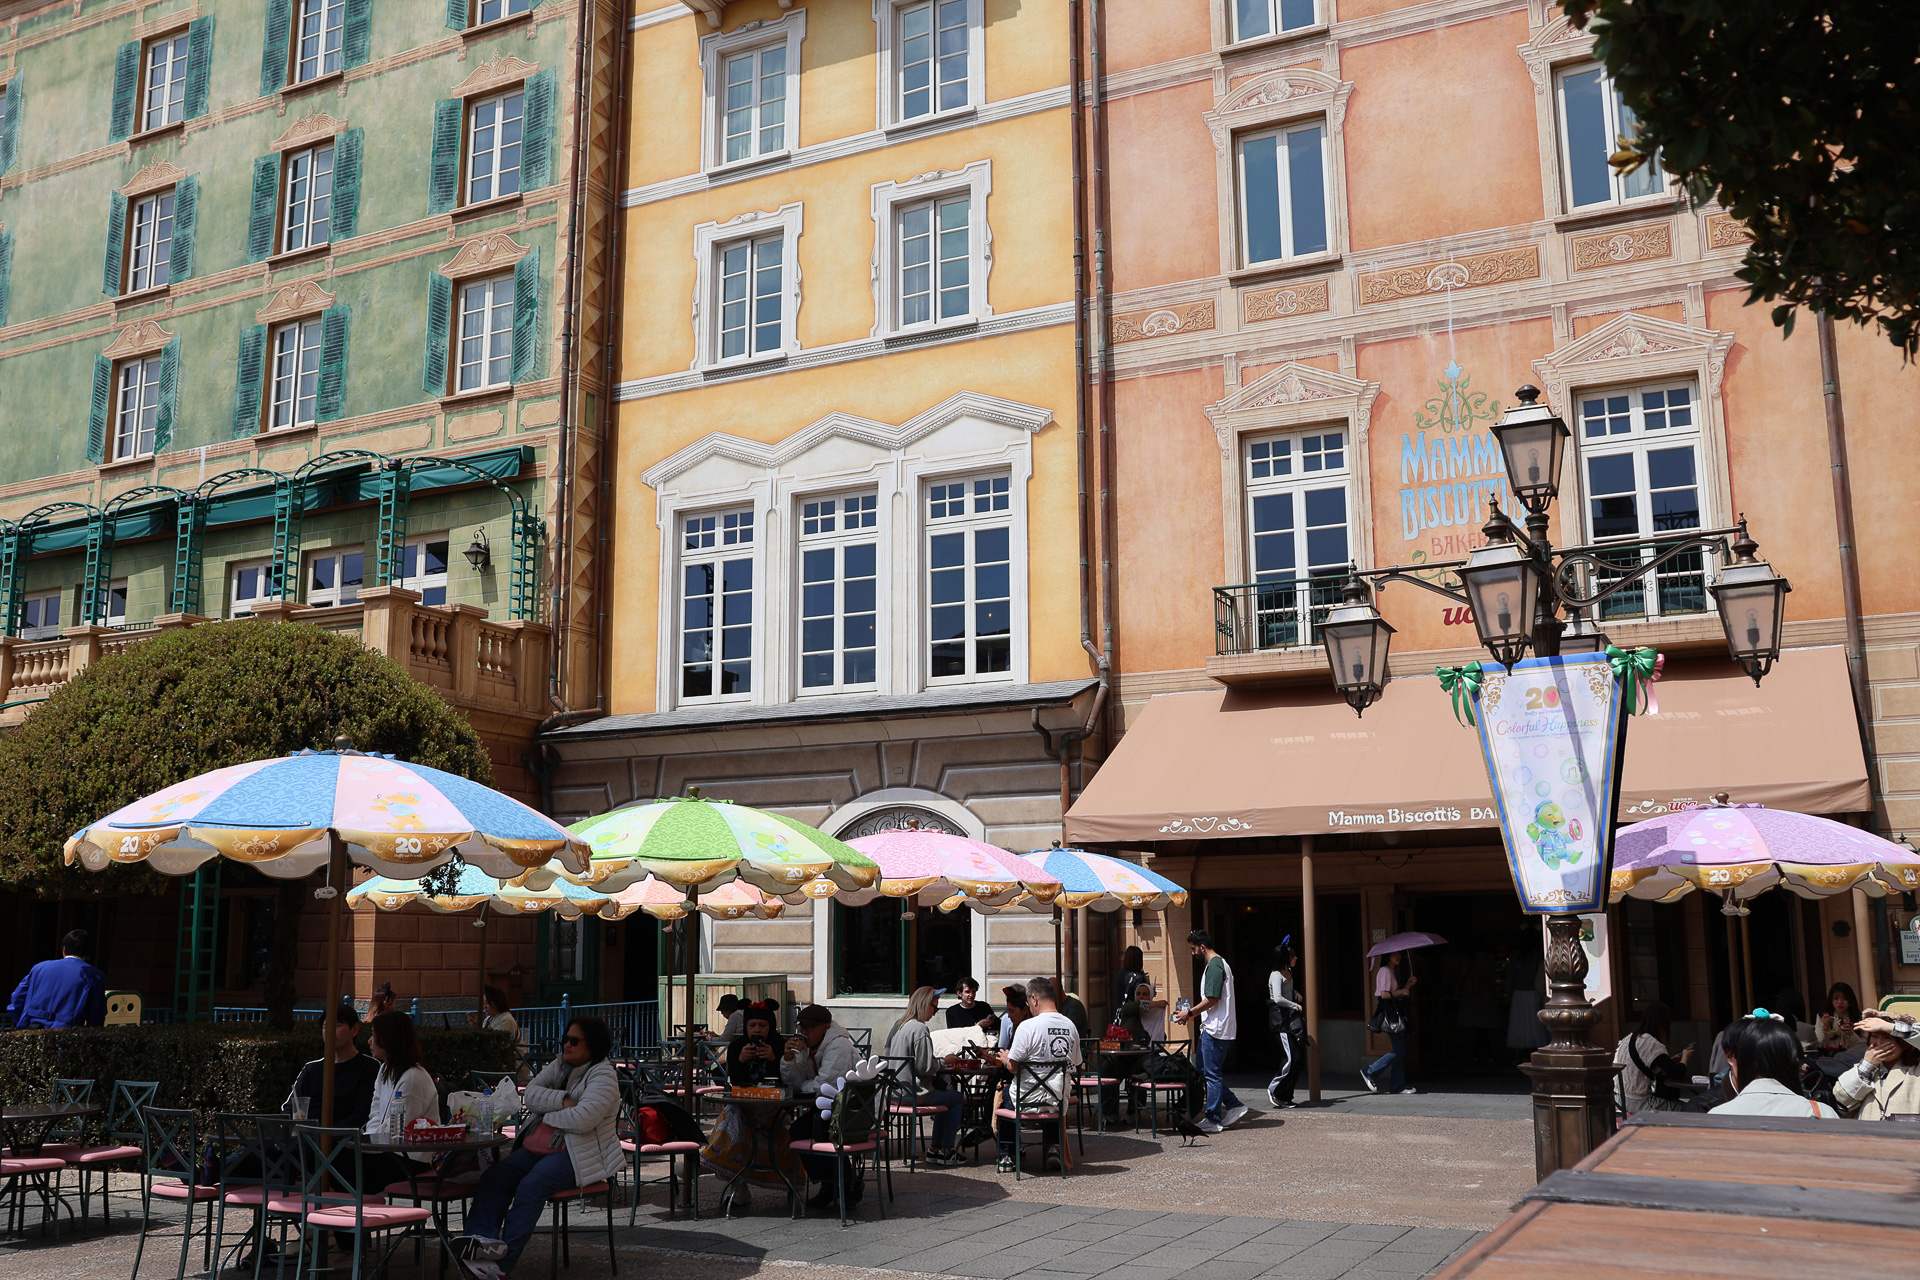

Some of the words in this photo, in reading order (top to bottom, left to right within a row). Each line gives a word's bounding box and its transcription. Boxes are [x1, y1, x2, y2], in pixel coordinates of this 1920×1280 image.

[1525, 686, 1560, 710] 20
[1496, 719, 1540, 736] Colorful
[1541, 715, 1599, 733] Happiness
[1328, 811, 1385, 826] Mamma
[1387, 807, 1461, 824] Biscotti's
[120, 836, 139, 852] 20
[395, 837, 421, 853] 20
[785, 867, 804, 878] 20
[1709, 870, 1730, 882] 20
[813, 884, 828, 893] 20
[976, 884, 991, 893] 20
[386, 897, 397, 905] 20
[525, 901, 538, 909] 20
[1132, 895, 1143, 904] 20
[727, 907, 738, 915] 20
